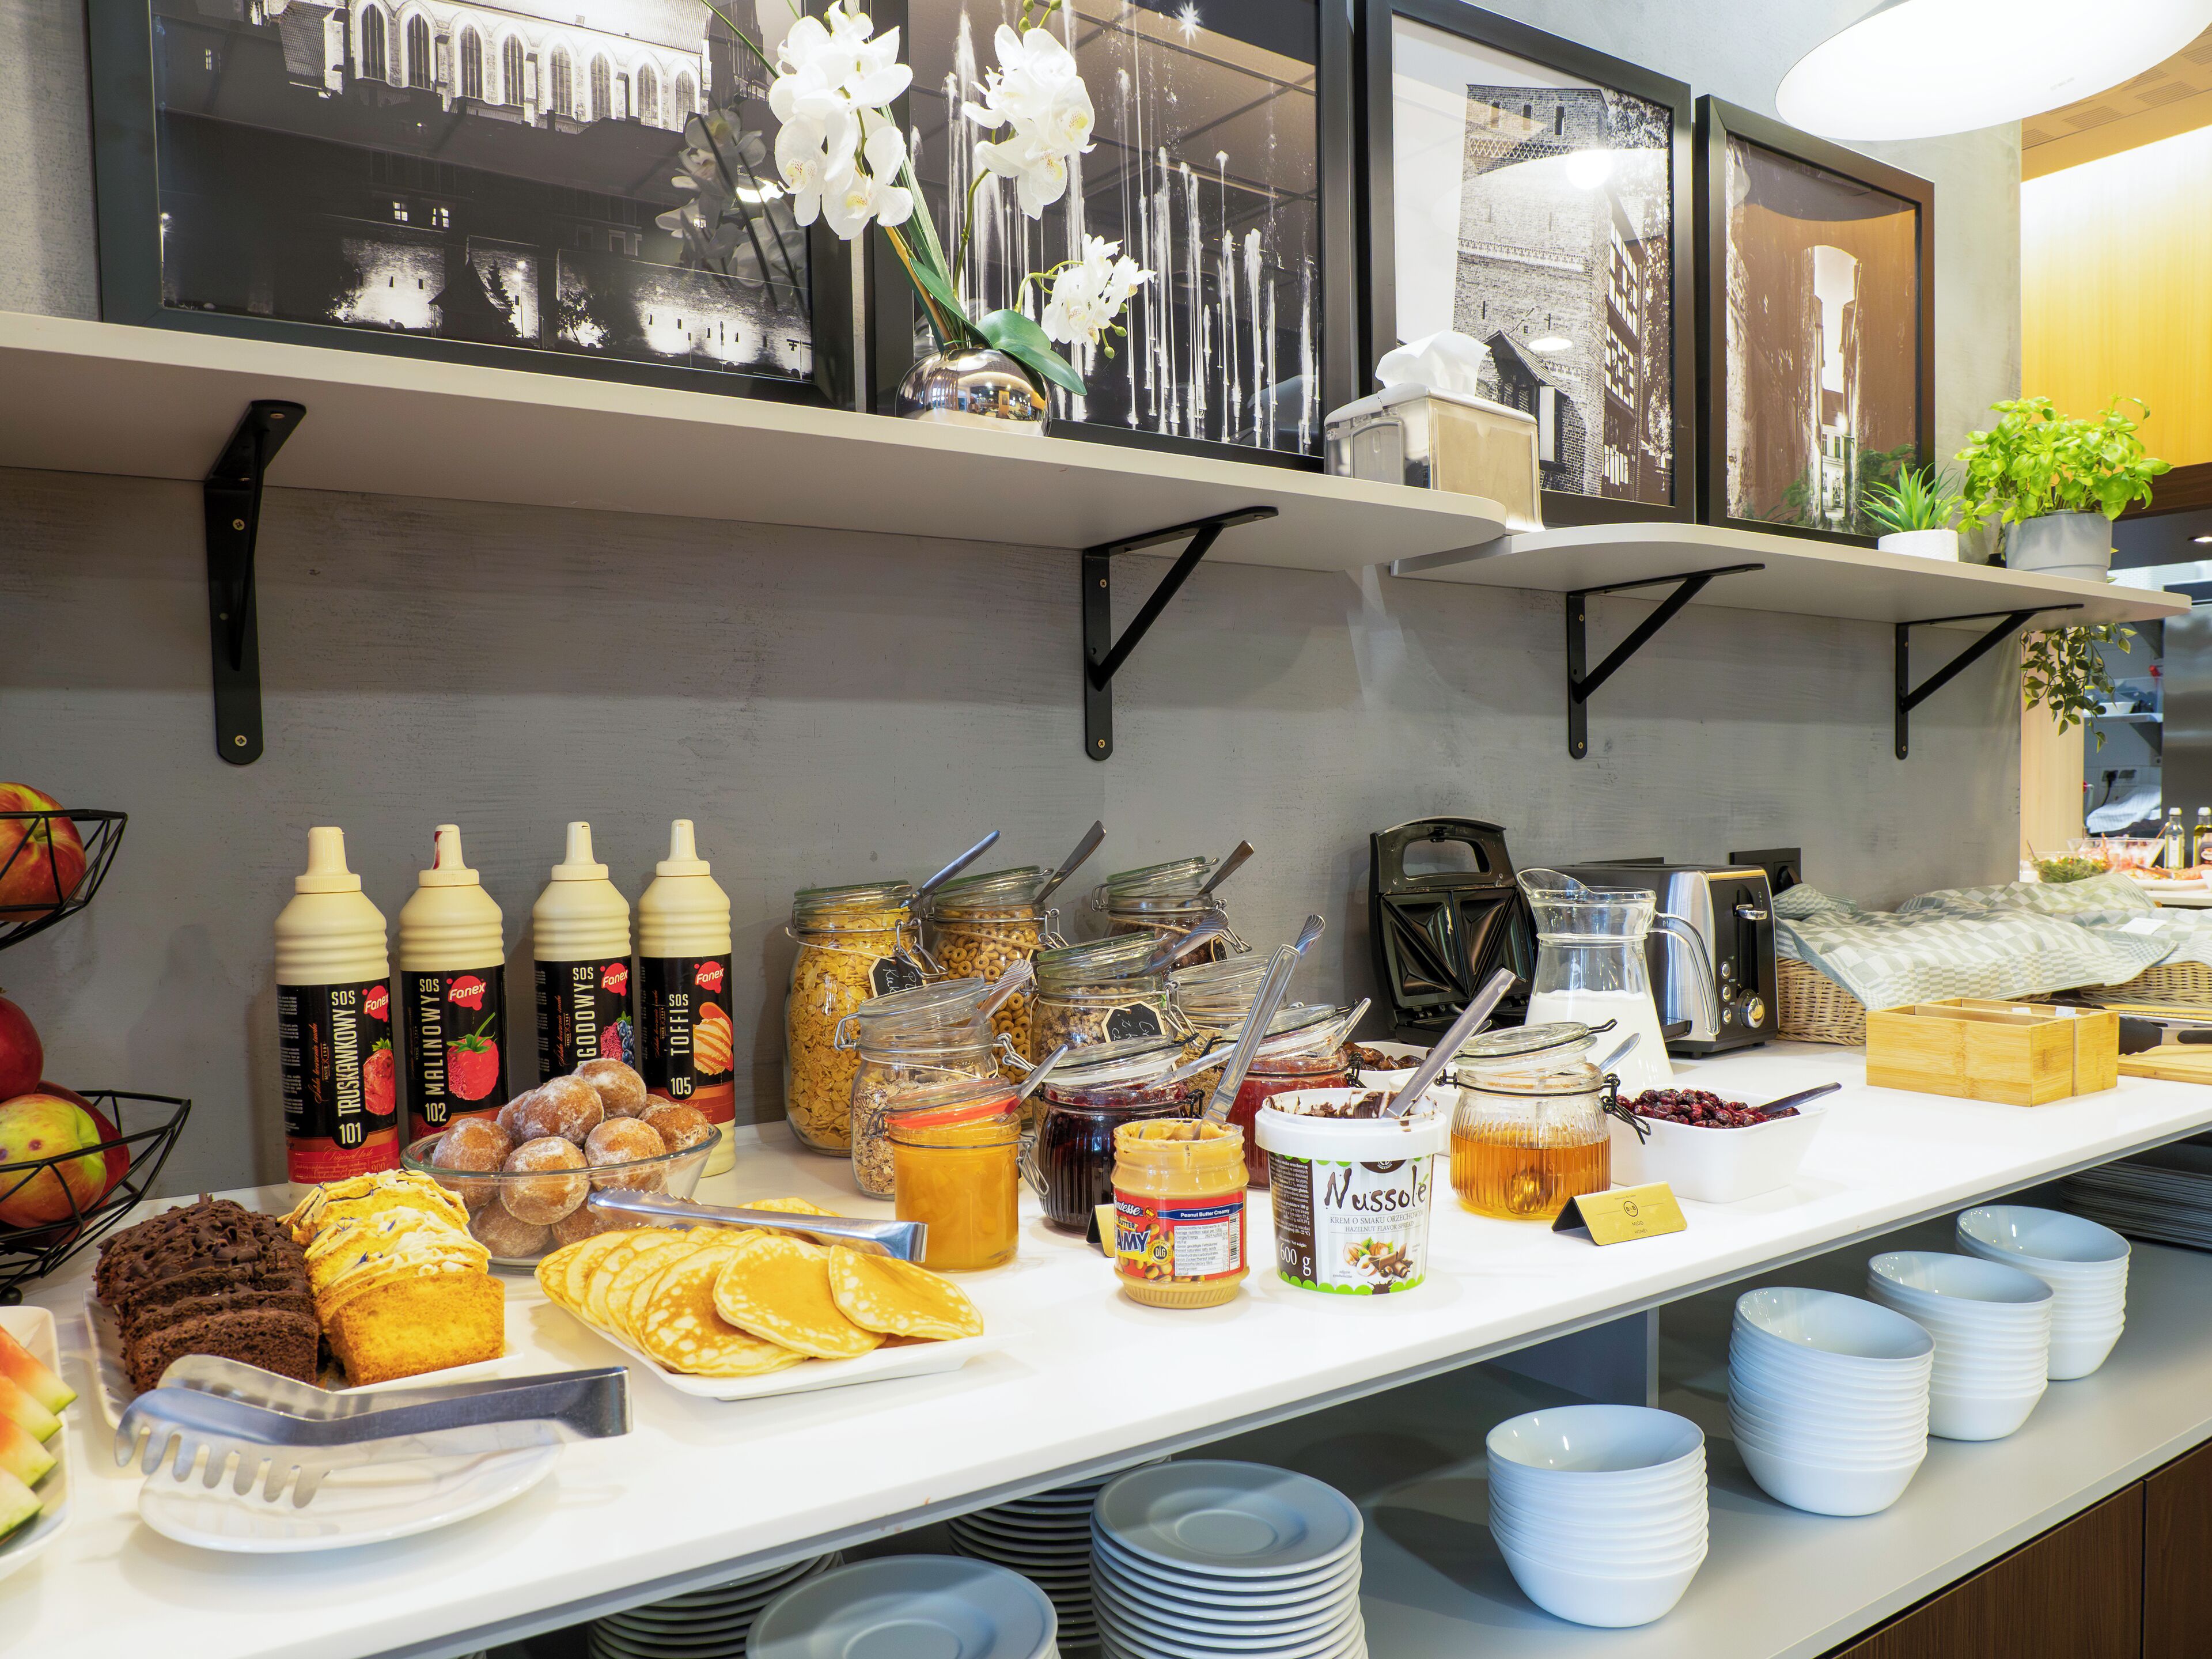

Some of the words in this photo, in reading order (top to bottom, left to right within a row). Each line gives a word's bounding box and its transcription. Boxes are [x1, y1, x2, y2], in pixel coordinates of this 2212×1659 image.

[573, 967, 593, 980] SOS
[603, 969, 628, 987] Fanex
[696, 967, 724, 984] Fanex
[882, 969, 900, 993] Kuk
[419, 979, 440, 992] SOS
[449, 983, 485, 1001] Fanex
[331, 990, 355, 1006] SOS
[365, 993, 389, 1013] Fanex
[669, 994, 688, 1006] SOS
[574, 983, 597, 1067] GODOWY
[669, 1009, 690, 1056] TOFFI
[421, 995, 445, 1095] MALINOWY
[332, 1008, 361, 1117] TRUSKAWKOWY
[671, 1077, 691, 1095] 105
[425, 1103, 446, 1122] 102
[339, 1122, 362, 1145] 101
[371, 1162, 385, 1172] 900
[1330, 1216, 1350, 1224] KREM
[1352, 1217, 1358, 1225] O
[1360, 1215, 1385, 1224] SMAKU
[1397, 1221, 1414, 1230] SPREAD
[1116, 1228, 1151, 1255] AMY
[1156, 1244, 1165, 1257] DLG
[1279, 1243, 1297, 1266] 600
[1302, 1256, 1311, 1276] g
